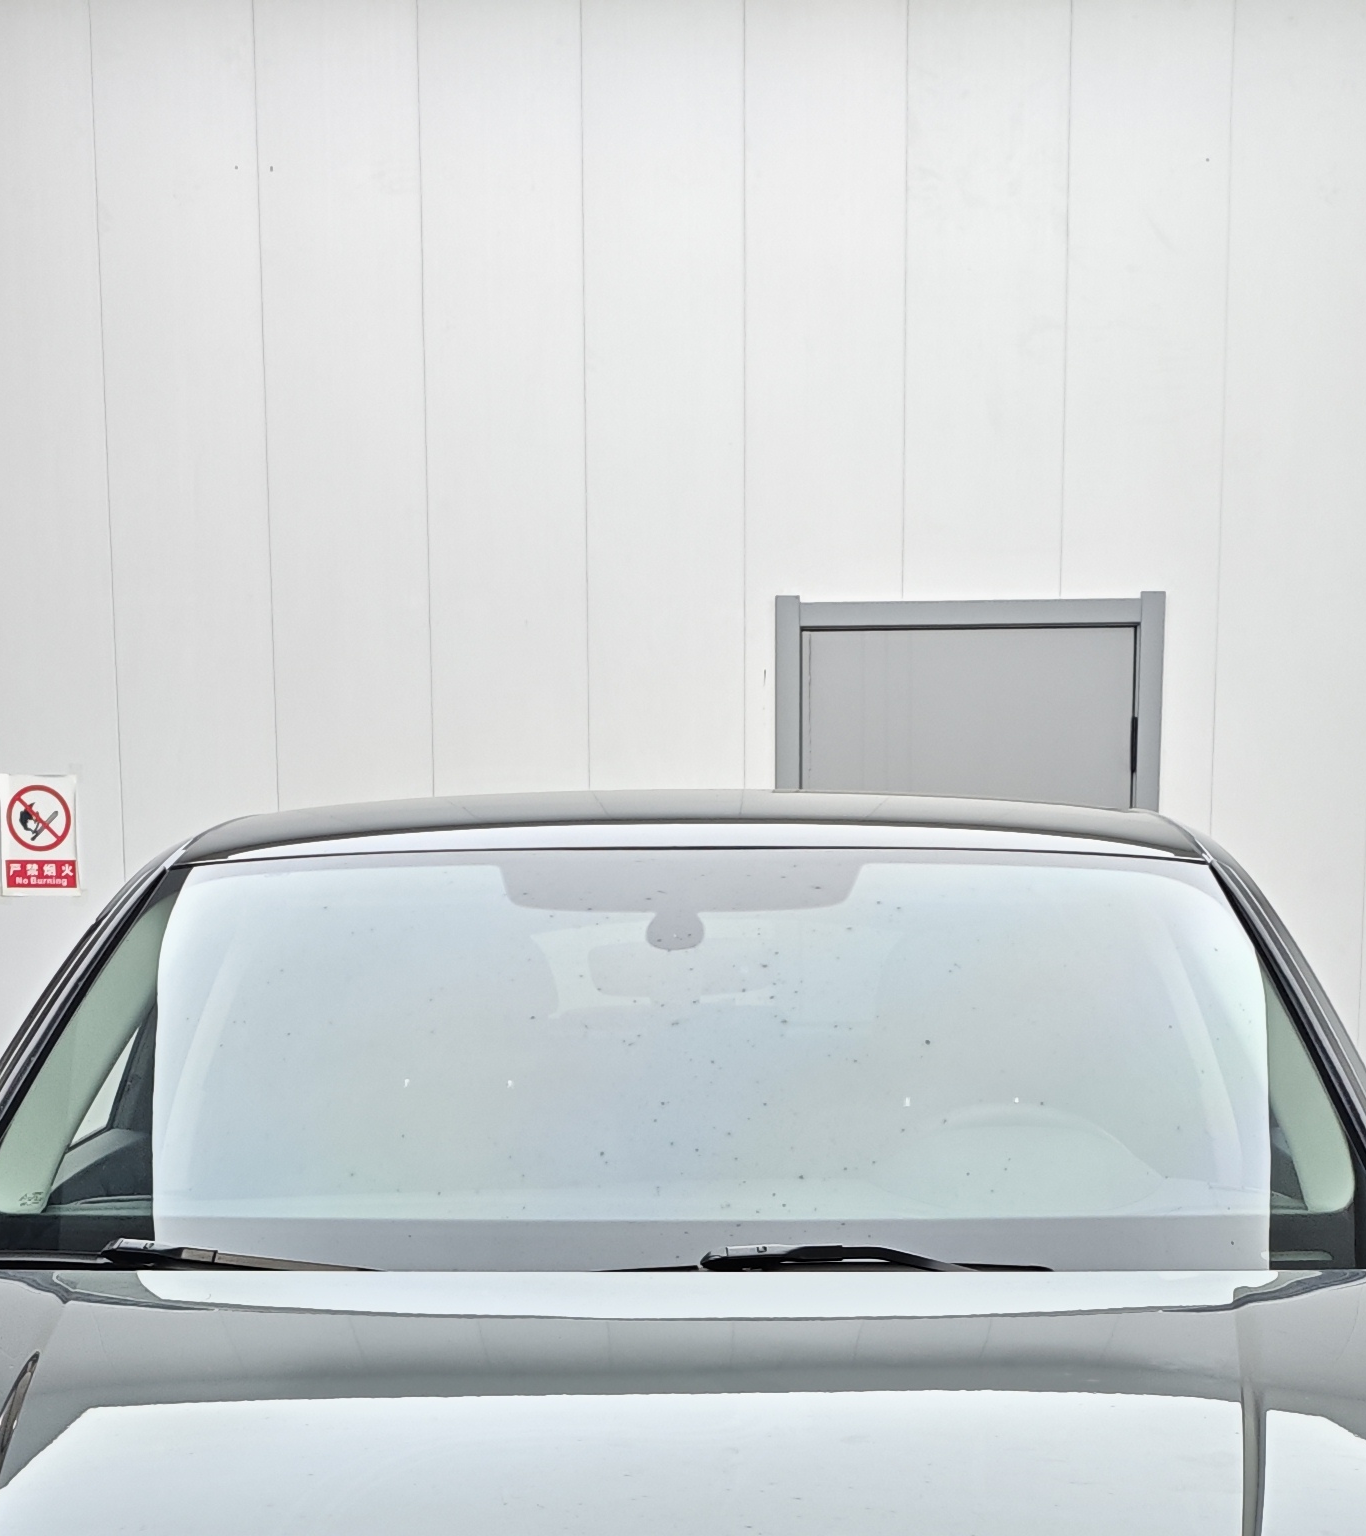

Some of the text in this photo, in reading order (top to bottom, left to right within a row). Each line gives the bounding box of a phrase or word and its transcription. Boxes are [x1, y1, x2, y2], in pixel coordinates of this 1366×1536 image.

[9, 863, 74, 876] 严禁烟火
[15, 877, 68, 887] No Burning
